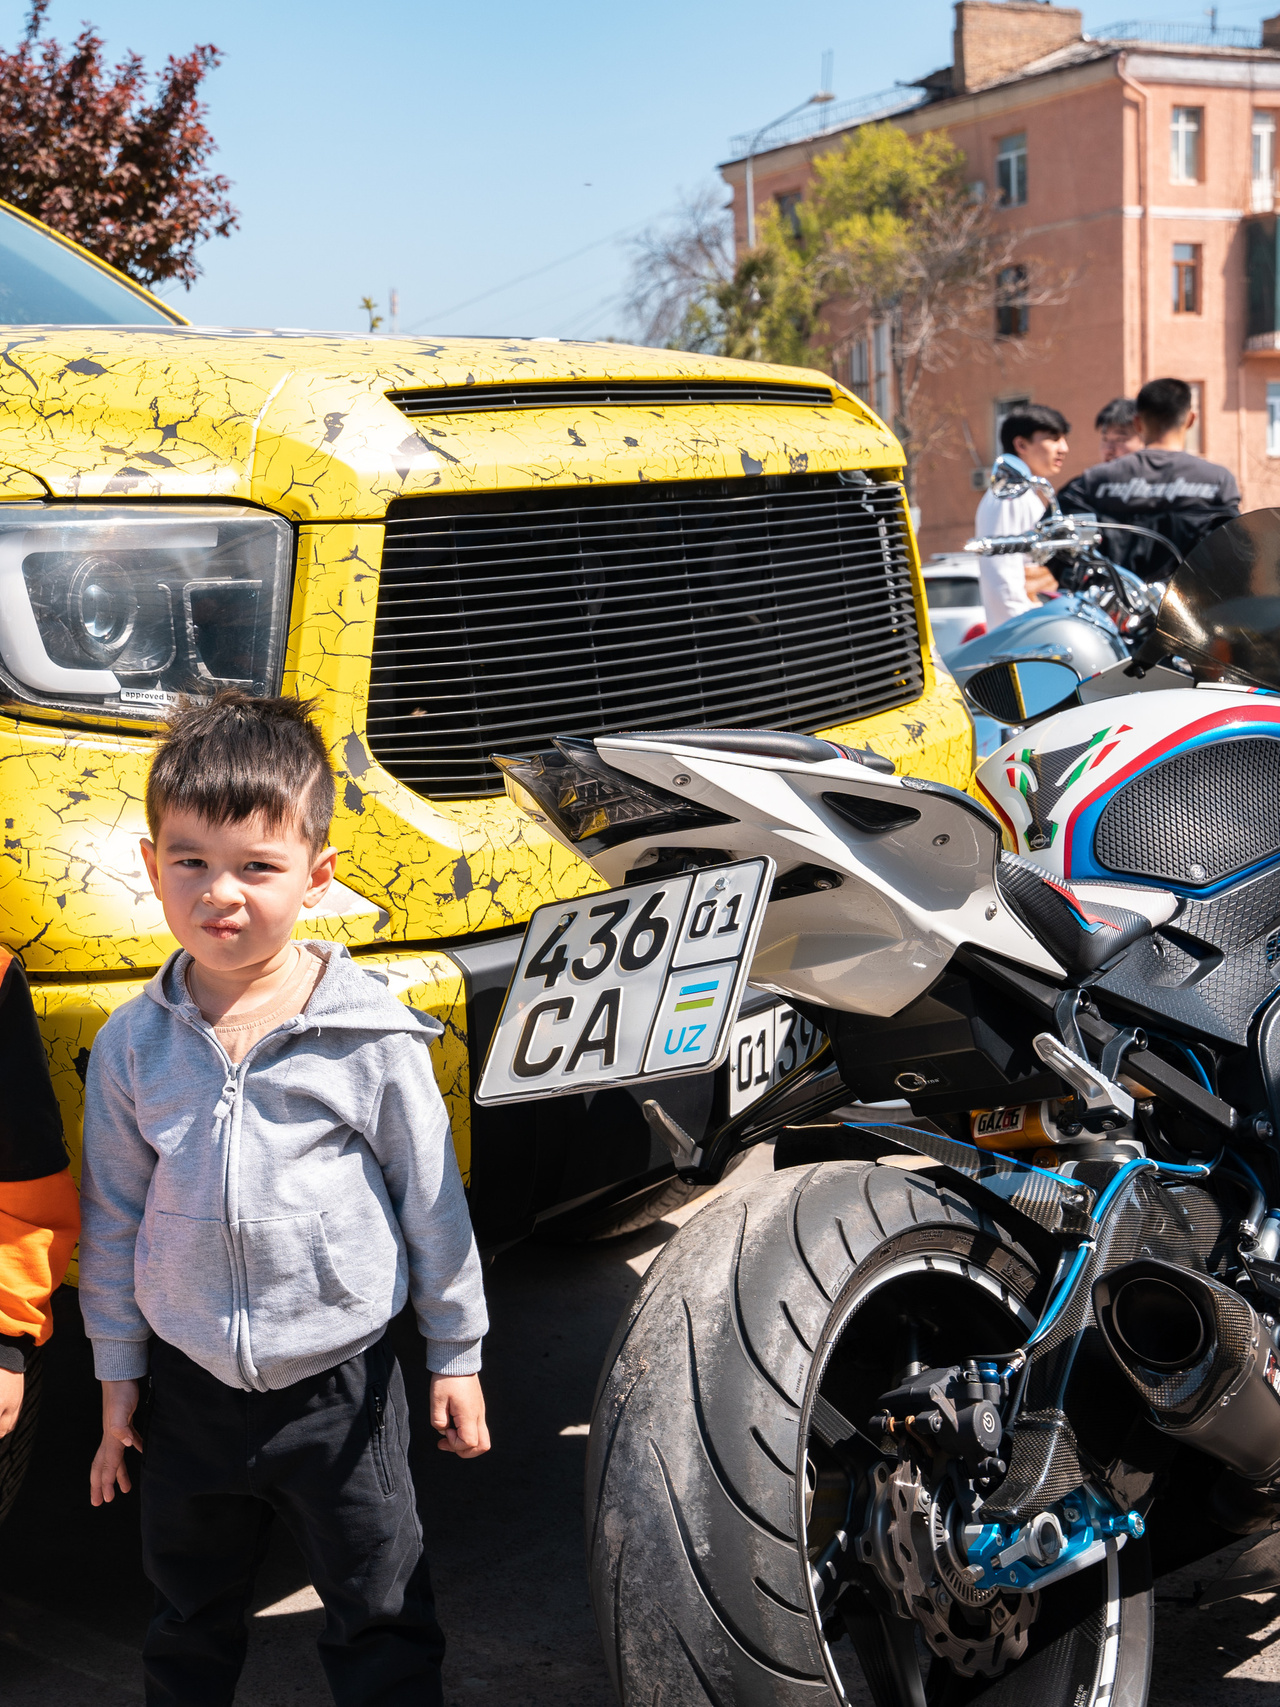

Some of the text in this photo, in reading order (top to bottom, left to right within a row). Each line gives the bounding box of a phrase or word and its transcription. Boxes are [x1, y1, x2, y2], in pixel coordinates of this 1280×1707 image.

[125, 690, 164, 701] approved
[166, 693, 177, 703] by
[523, 890, 669, 988] 436
[689, 894, 744, 939] 01
[513, 987, 622, 1077] CA
[664, 1024, 707, 1054] UZ
[737, 1029, 770, 1092] 01
